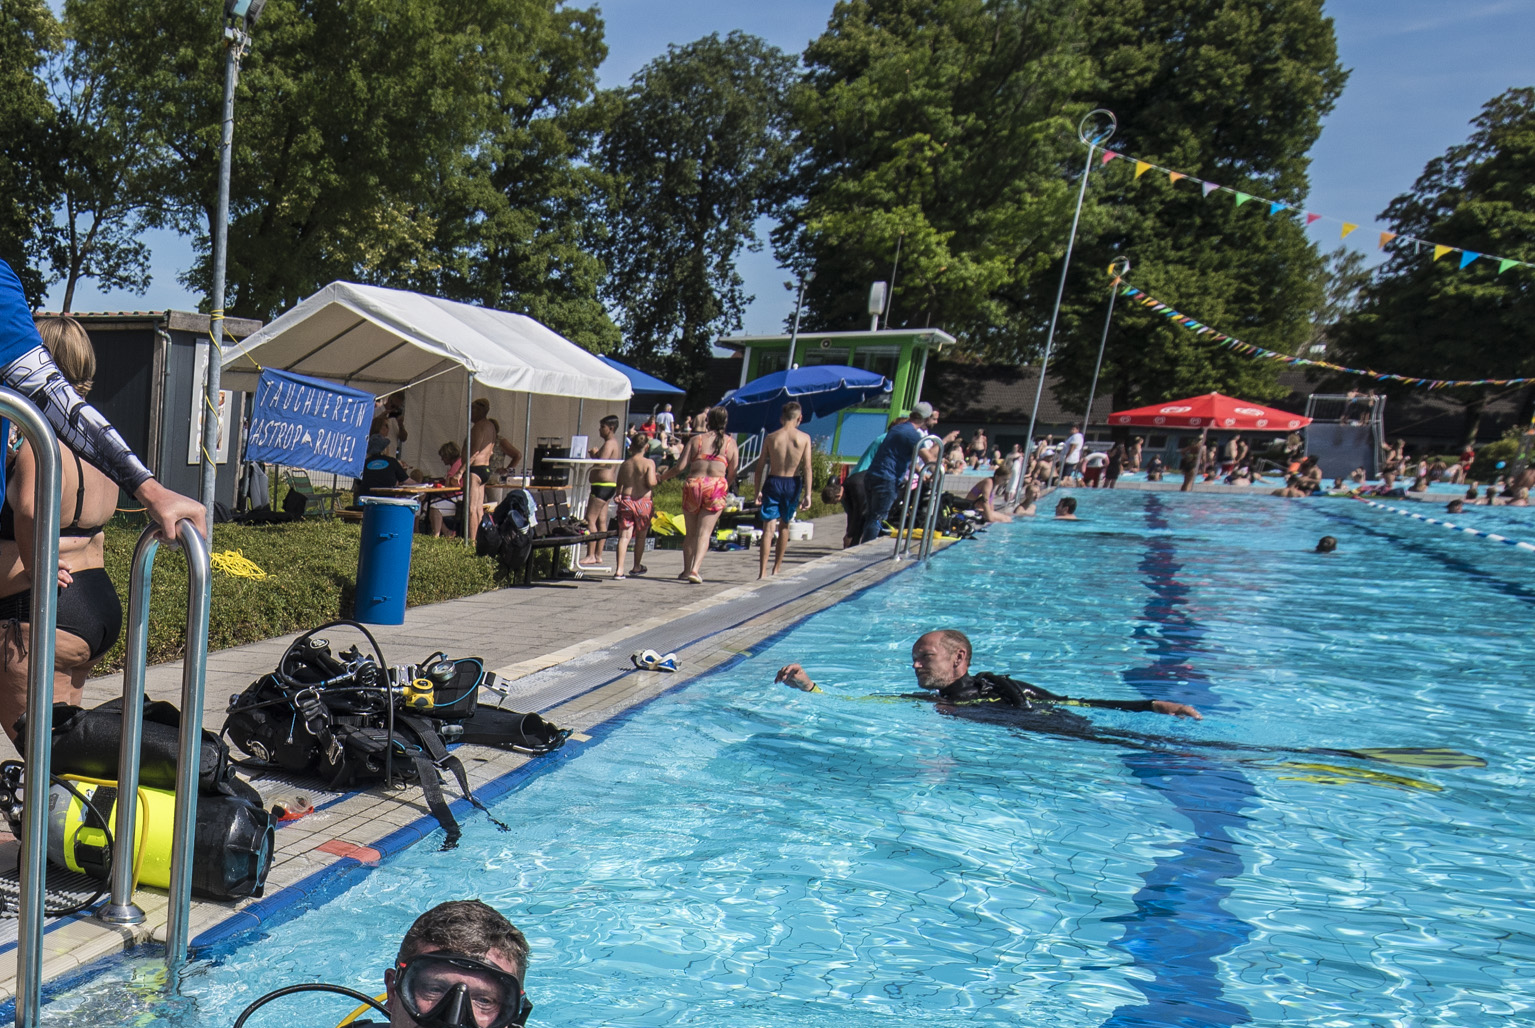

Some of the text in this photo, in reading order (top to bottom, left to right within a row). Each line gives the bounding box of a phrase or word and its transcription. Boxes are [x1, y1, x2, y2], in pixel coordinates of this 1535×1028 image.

[259, 381, 368, 428] TAUCHVEREIN
[249, 417, 357, 462] CASTROP RAUXEL
